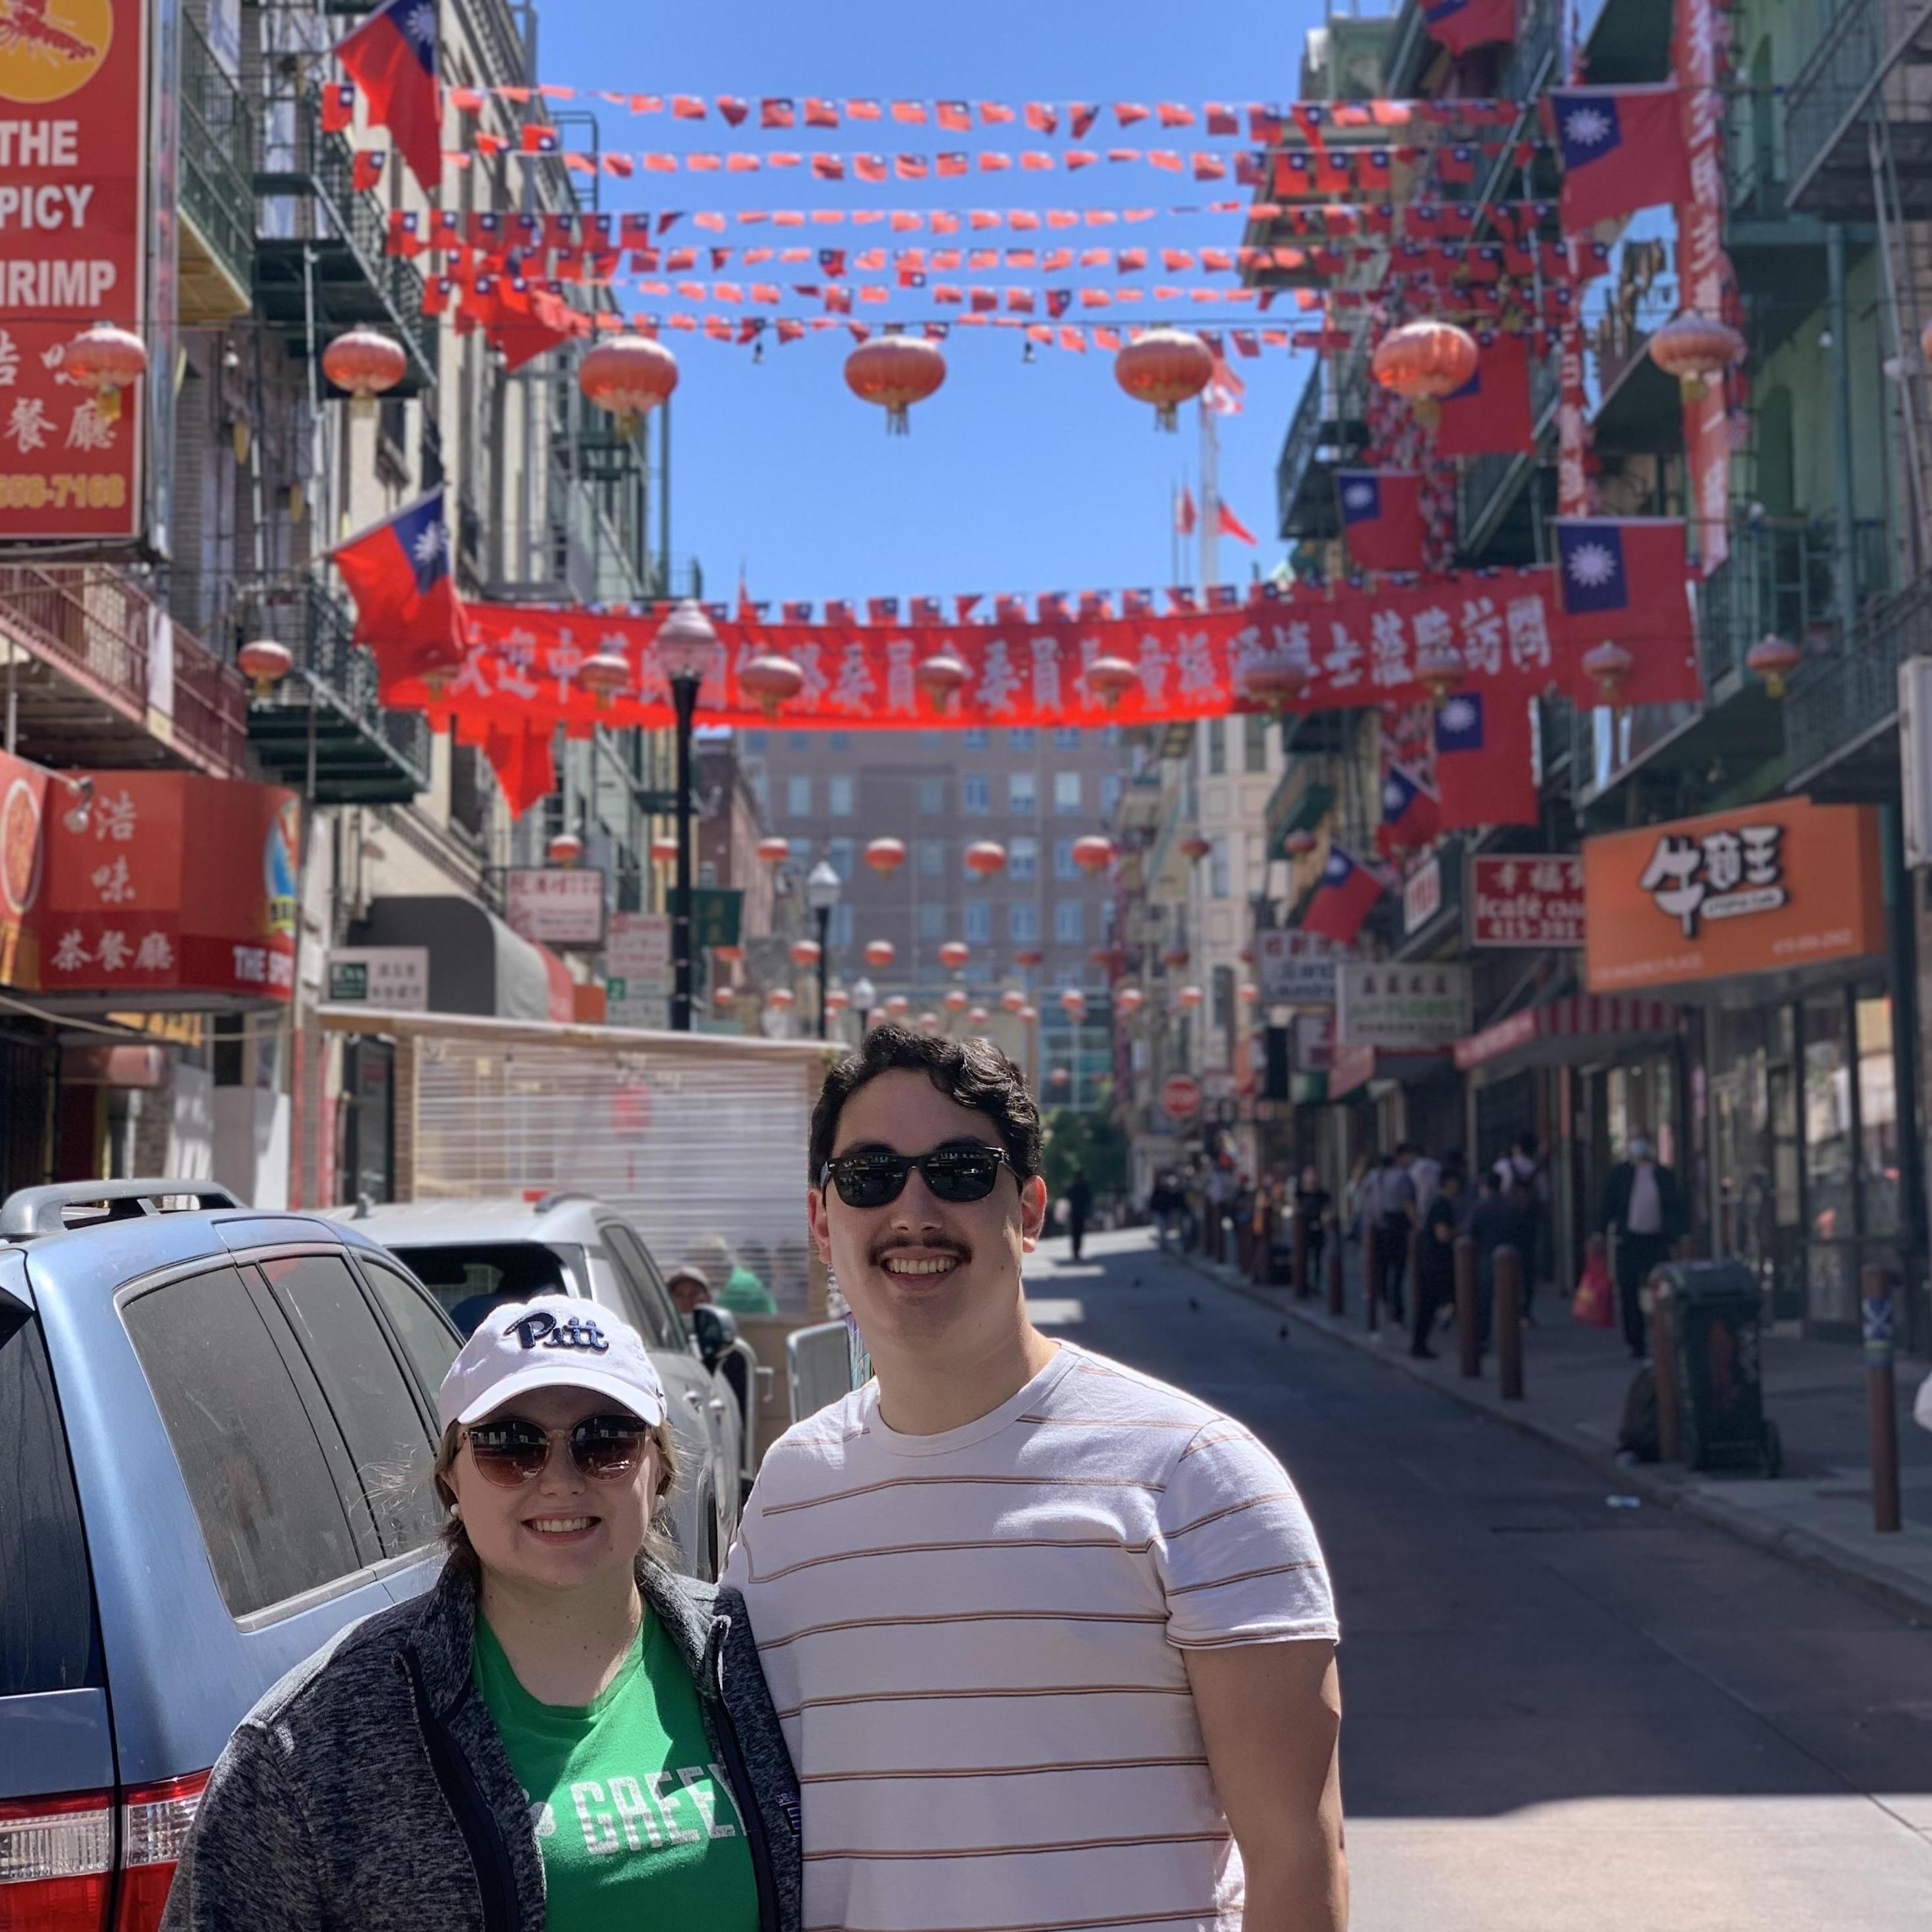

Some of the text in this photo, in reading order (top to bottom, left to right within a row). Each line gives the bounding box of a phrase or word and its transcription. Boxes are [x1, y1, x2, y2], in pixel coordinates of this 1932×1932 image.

[0, 120, 78, 165] THE
[51, 930, 174, 971] 茶餐廳
[504, 1312, 610, 1353] Pitt
